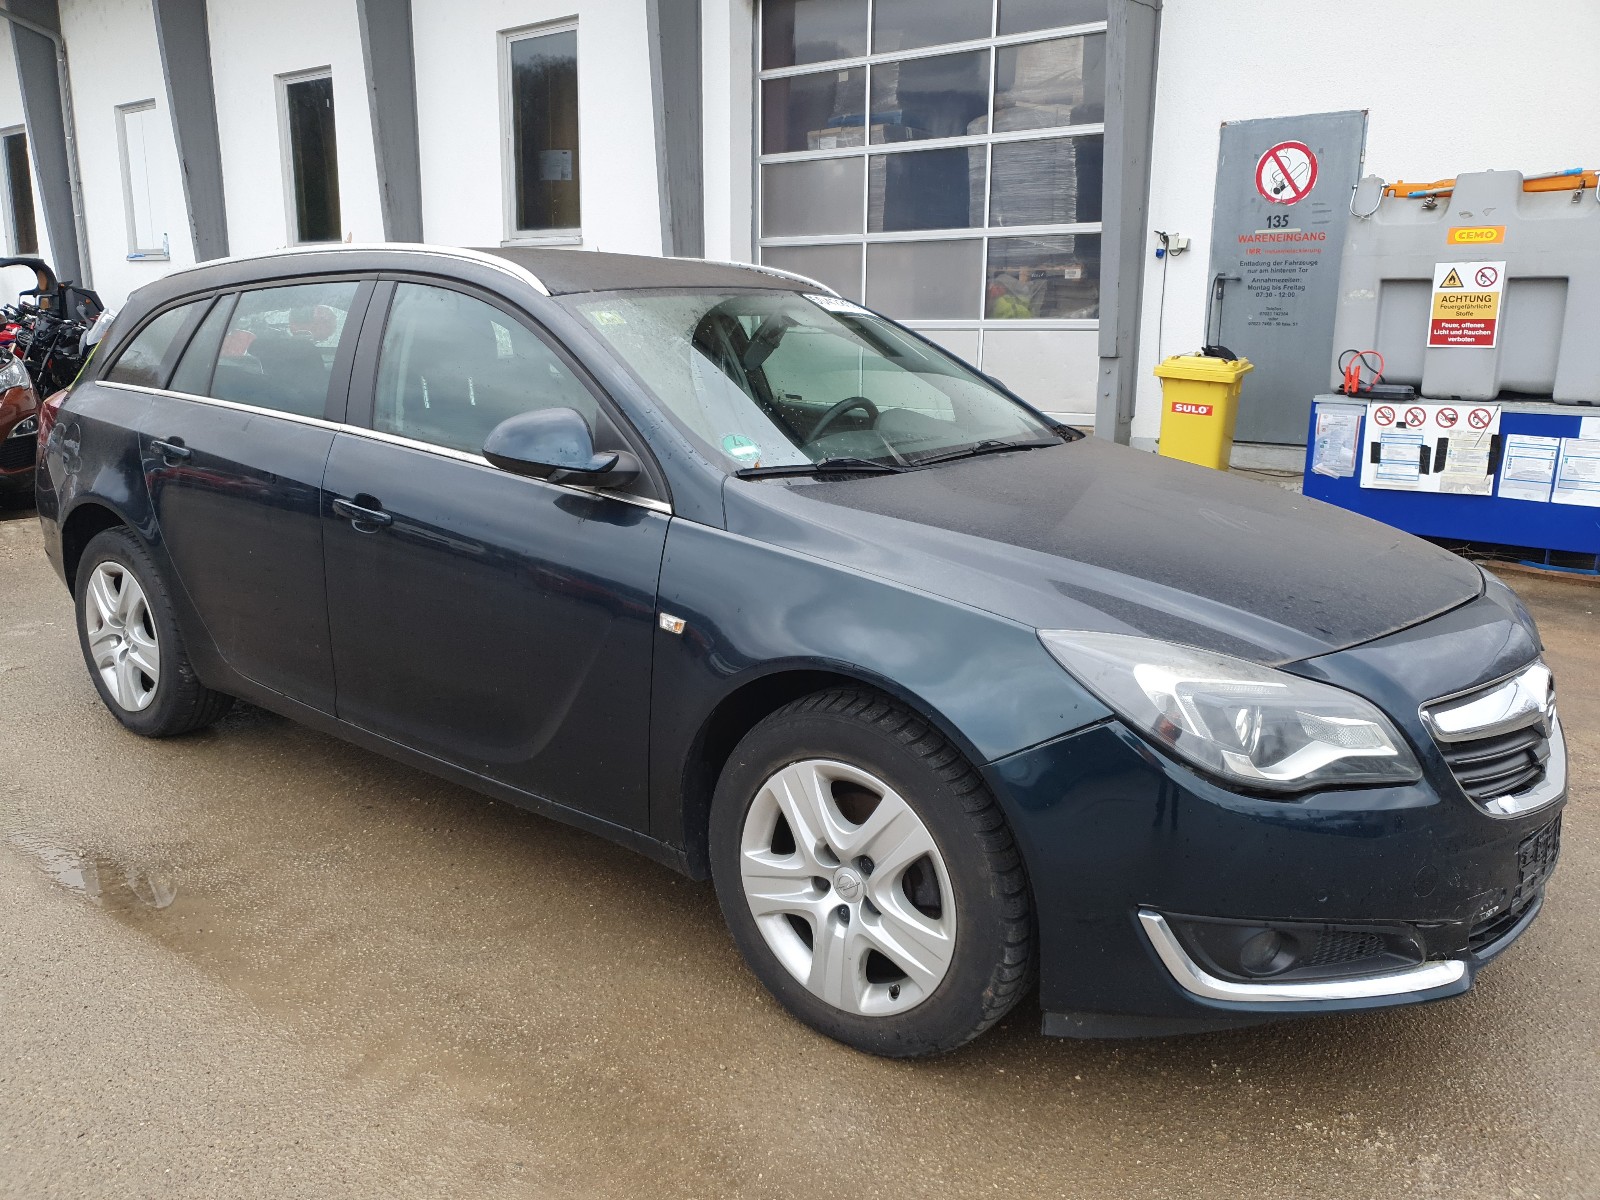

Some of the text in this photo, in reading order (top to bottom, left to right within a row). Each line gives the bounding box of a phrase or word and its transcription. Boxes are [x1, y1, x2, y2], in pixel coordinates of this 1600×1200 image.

[1266, 214, 1290, 228] 135
[1238, 232, 1326, 243] WARENEINGANG
[1458, 231, 1494, 240] CEMO
[1441, 295, 1492, 303] ACHTUNG
[1175, 404, 1207, 414] SULO
[733, 436, 744, 446] 4
